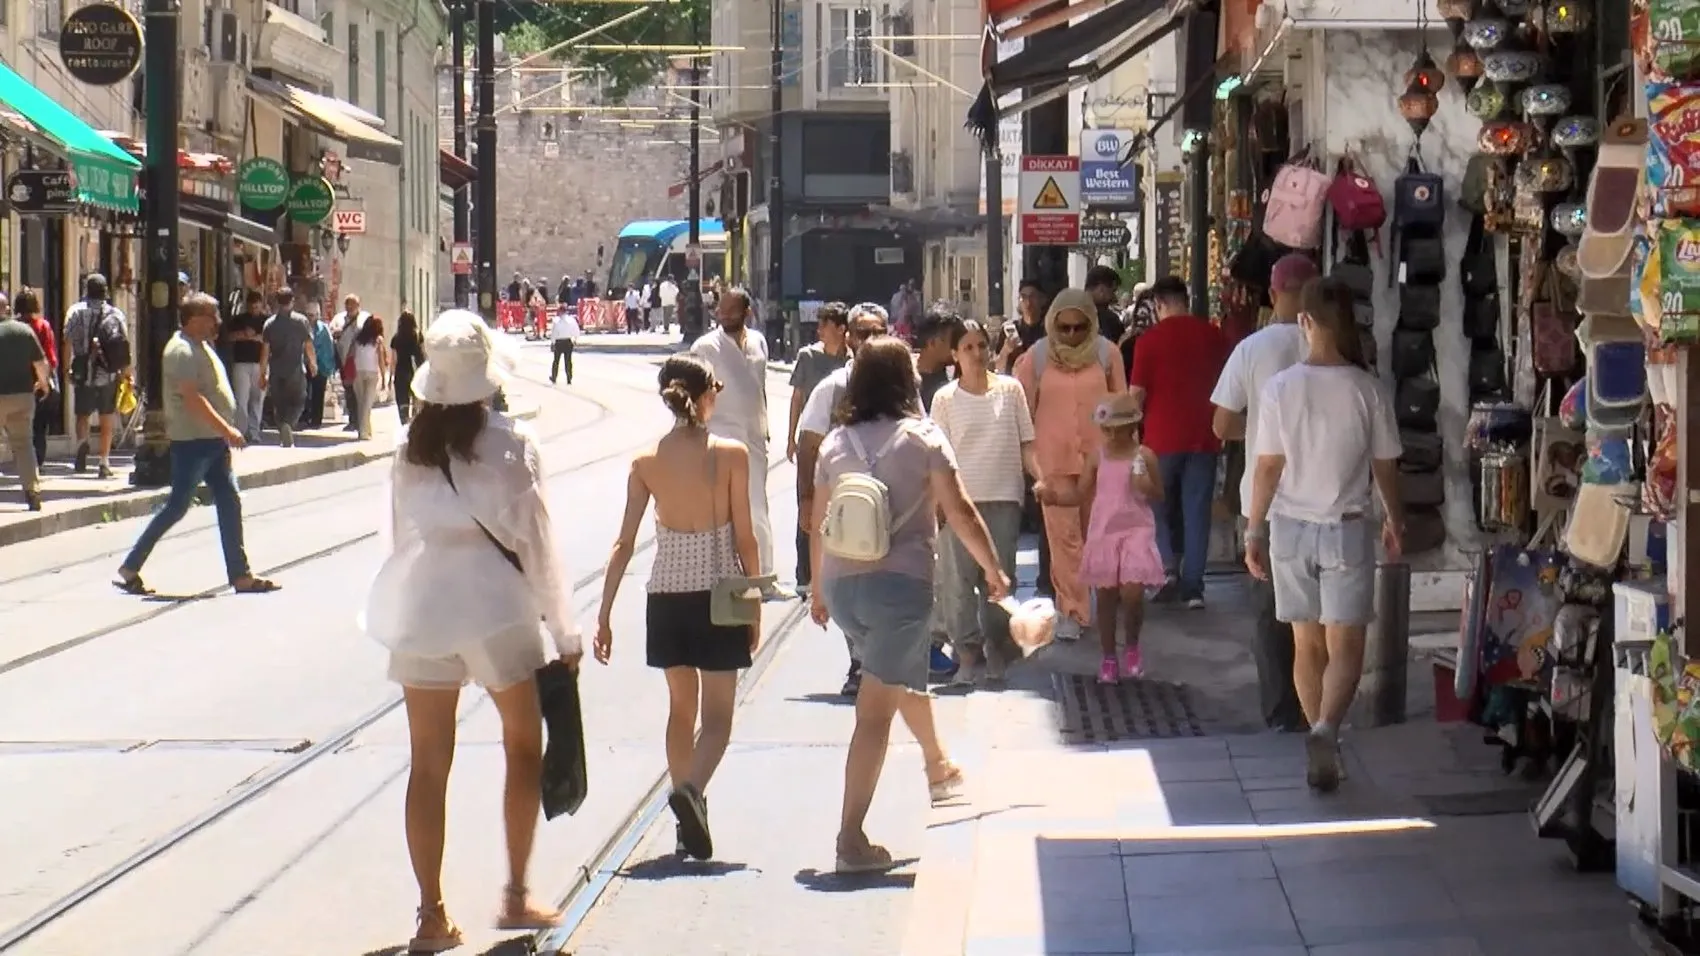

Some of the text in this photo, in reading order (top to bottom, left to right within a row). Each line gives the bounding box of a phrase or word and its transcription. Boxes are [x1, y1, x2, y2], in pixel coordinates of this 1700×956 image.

[67, 57, 132, 68] restaurant
[1097, 140, 1118, 153] BW
[1028, 159, 1073, 170] DİKKAT!
[1095, 168, 1119, 179] Best
[239, 183, 285, 194] HILLTOP
[1085, 177, 1129, 189] Western
[288, 199, 330, 209] HILLTOP
[336, 213, 362, 224] WC
[1102, 227, 1125, 237] CHEF
[1082, 236, 1122, 244] STAURANT
